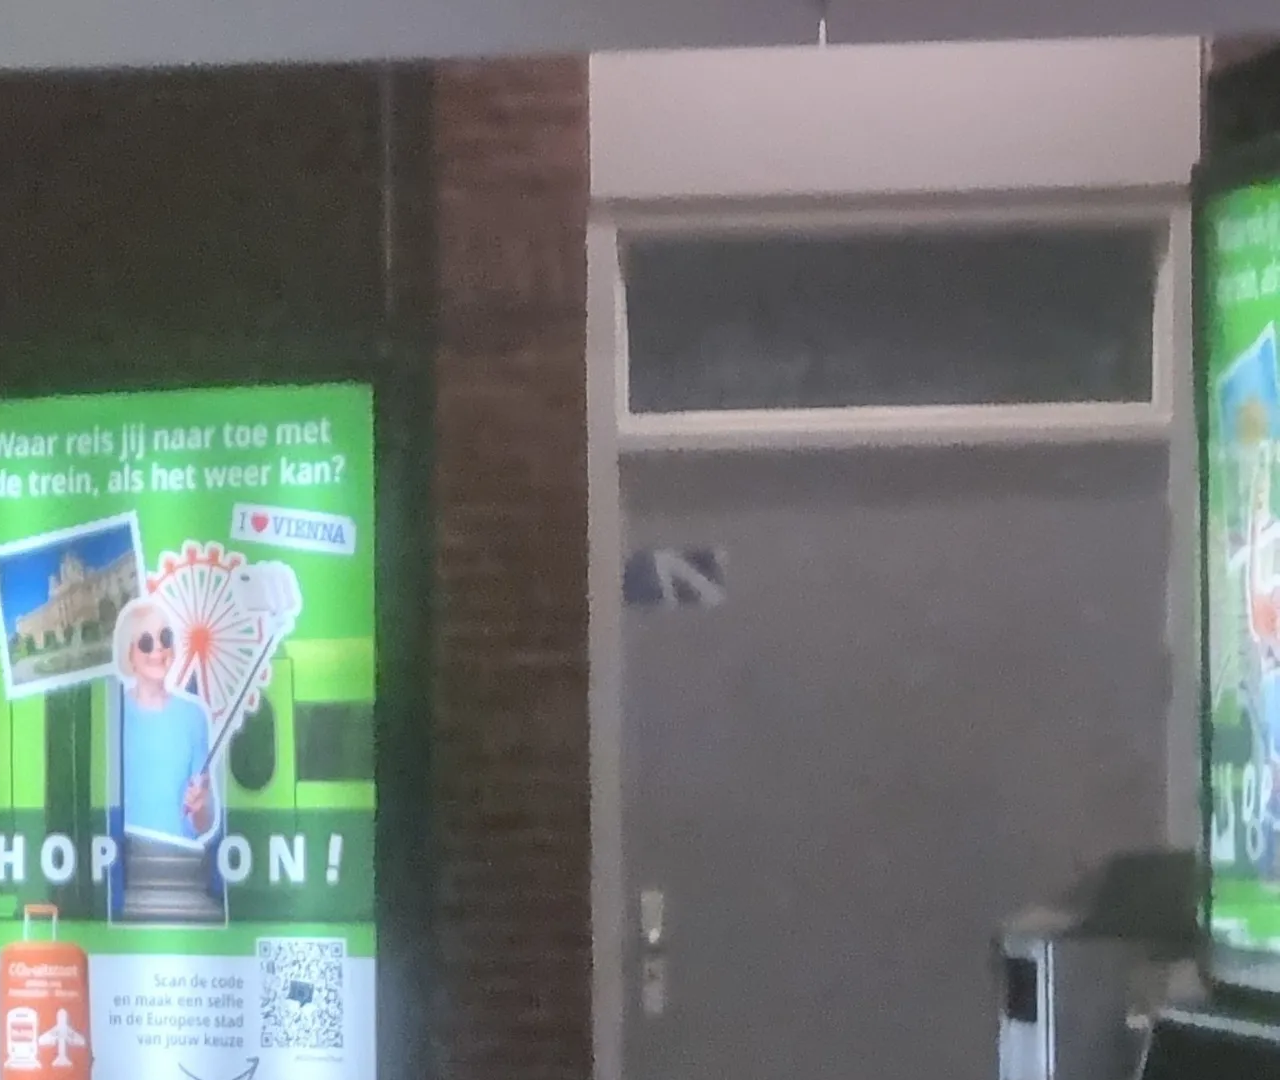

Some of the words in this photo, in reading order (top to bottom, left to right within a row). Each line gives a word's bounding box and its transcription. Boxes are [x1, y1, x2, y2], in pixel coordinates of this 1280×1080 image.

[65, 426, 113, 456] reis
[118, 423, 146, 461] jij
[153, 425, 214, 451] naar
[223, 422, 267, 448] toe
[276, 418, 331, 445] met
[28, 465, 99, 497] trein,
[108, 463, 144, 493] als
[151, 460, 197, 491] het
[205, 463, 270, 489] weer
[279, 455, 346, 486] kan?
[272, 519, 346, 546] VIENNA
[154, 973, 187, 988] Scan
[190, 974, 208, 989] de
[211, 975, 244, 989] code
[113, 995, 131, 1007] en
[135, 994, 172, 1007] maak
[177, 996, 203, 1008] een
[208, 994, 244, 1009] selfie
[109, 1011, 122, 1025] in
[125, 1012, 143, 1026] de
[147, 1012, 211, 1030] Europese
[214, 1014, 244, 1028] stad
[137, 1034, 161, 1046] van
[165, 1033, 200, 1048] jouw
[204, 1034, 244, 1048] keuze
